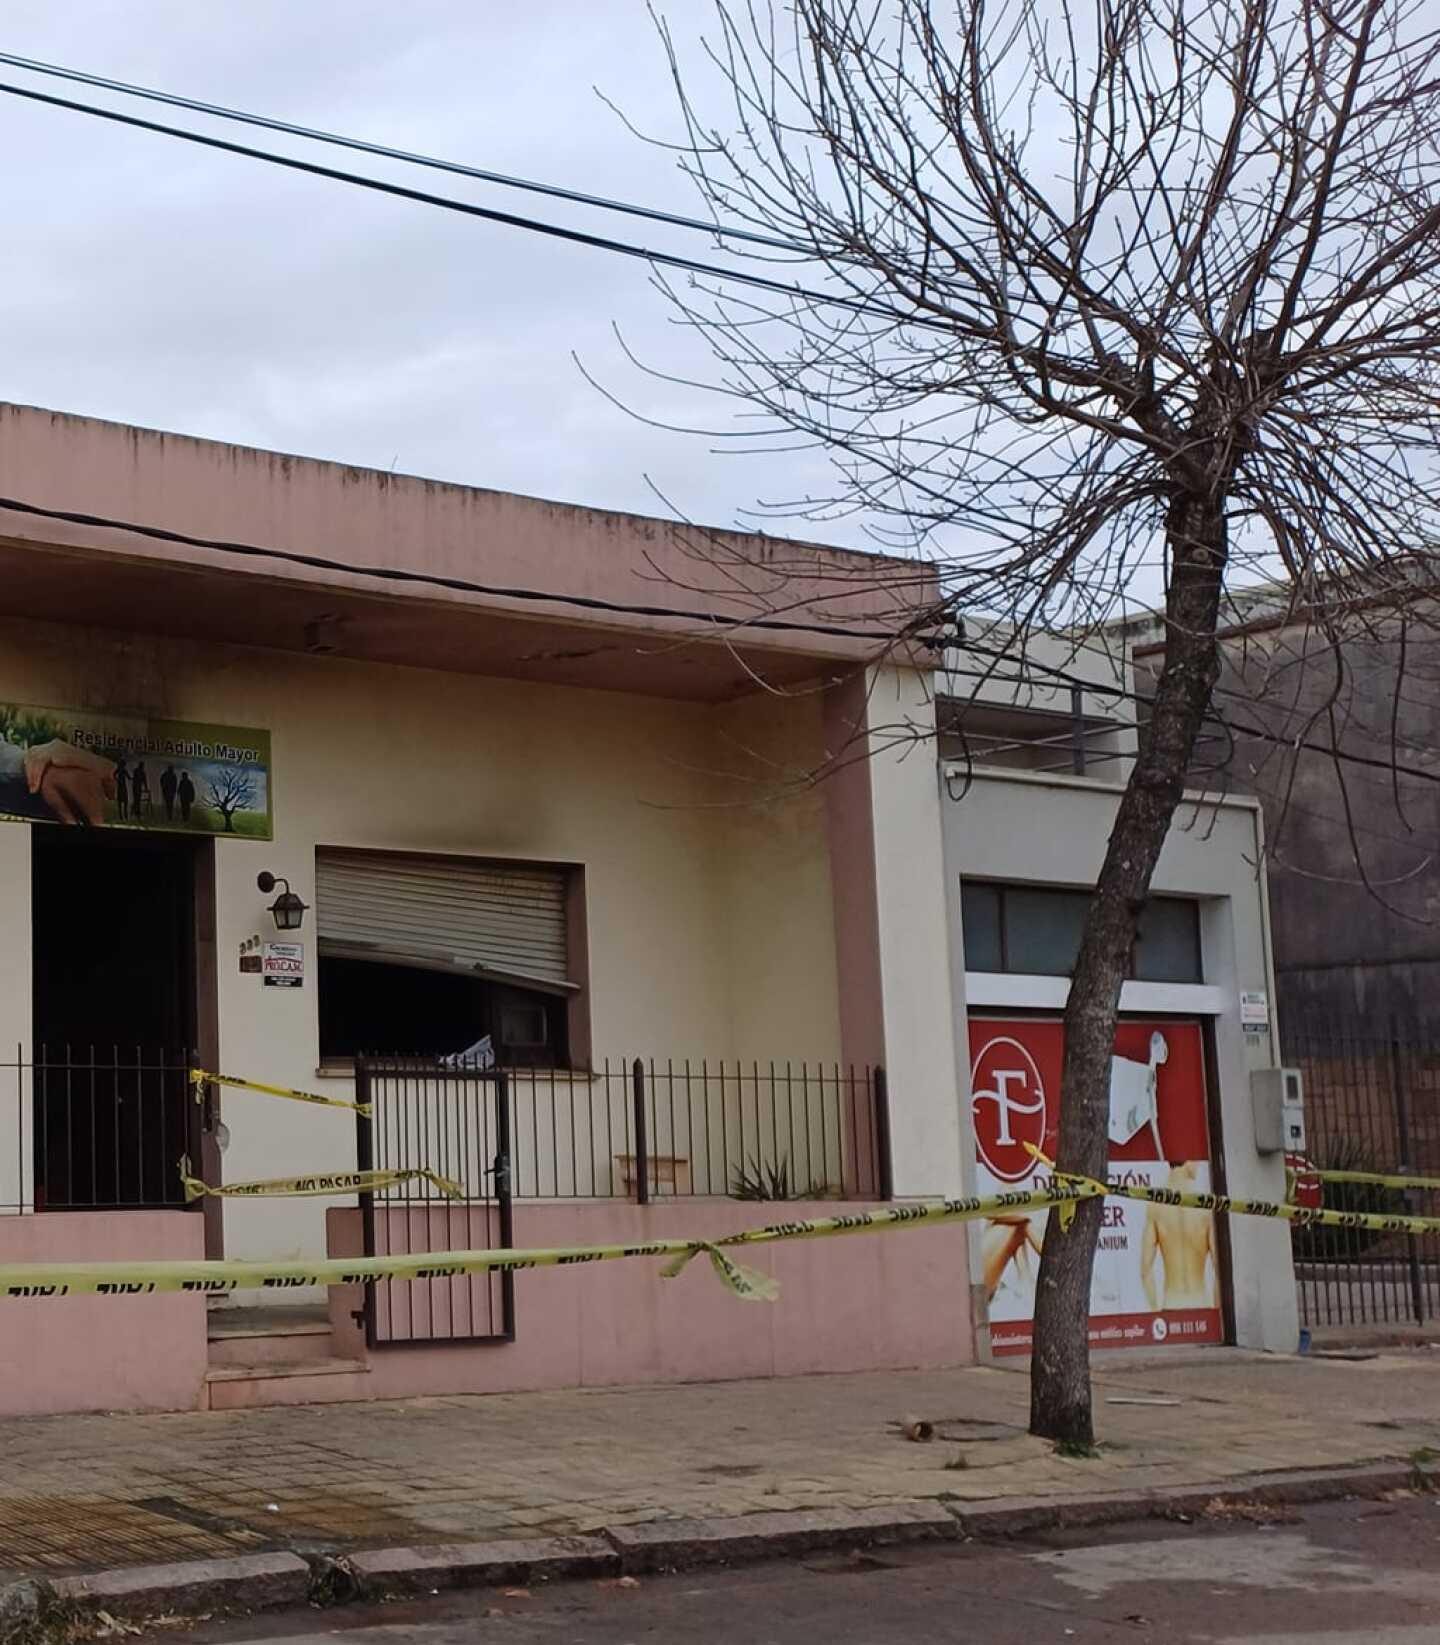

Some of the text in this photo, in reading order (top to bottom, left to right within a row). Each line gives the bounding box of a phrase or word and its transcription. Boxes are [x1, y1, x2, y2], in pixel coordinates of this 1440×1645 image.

[74, 729, 258, 763] Residencial Adulto Mayor
